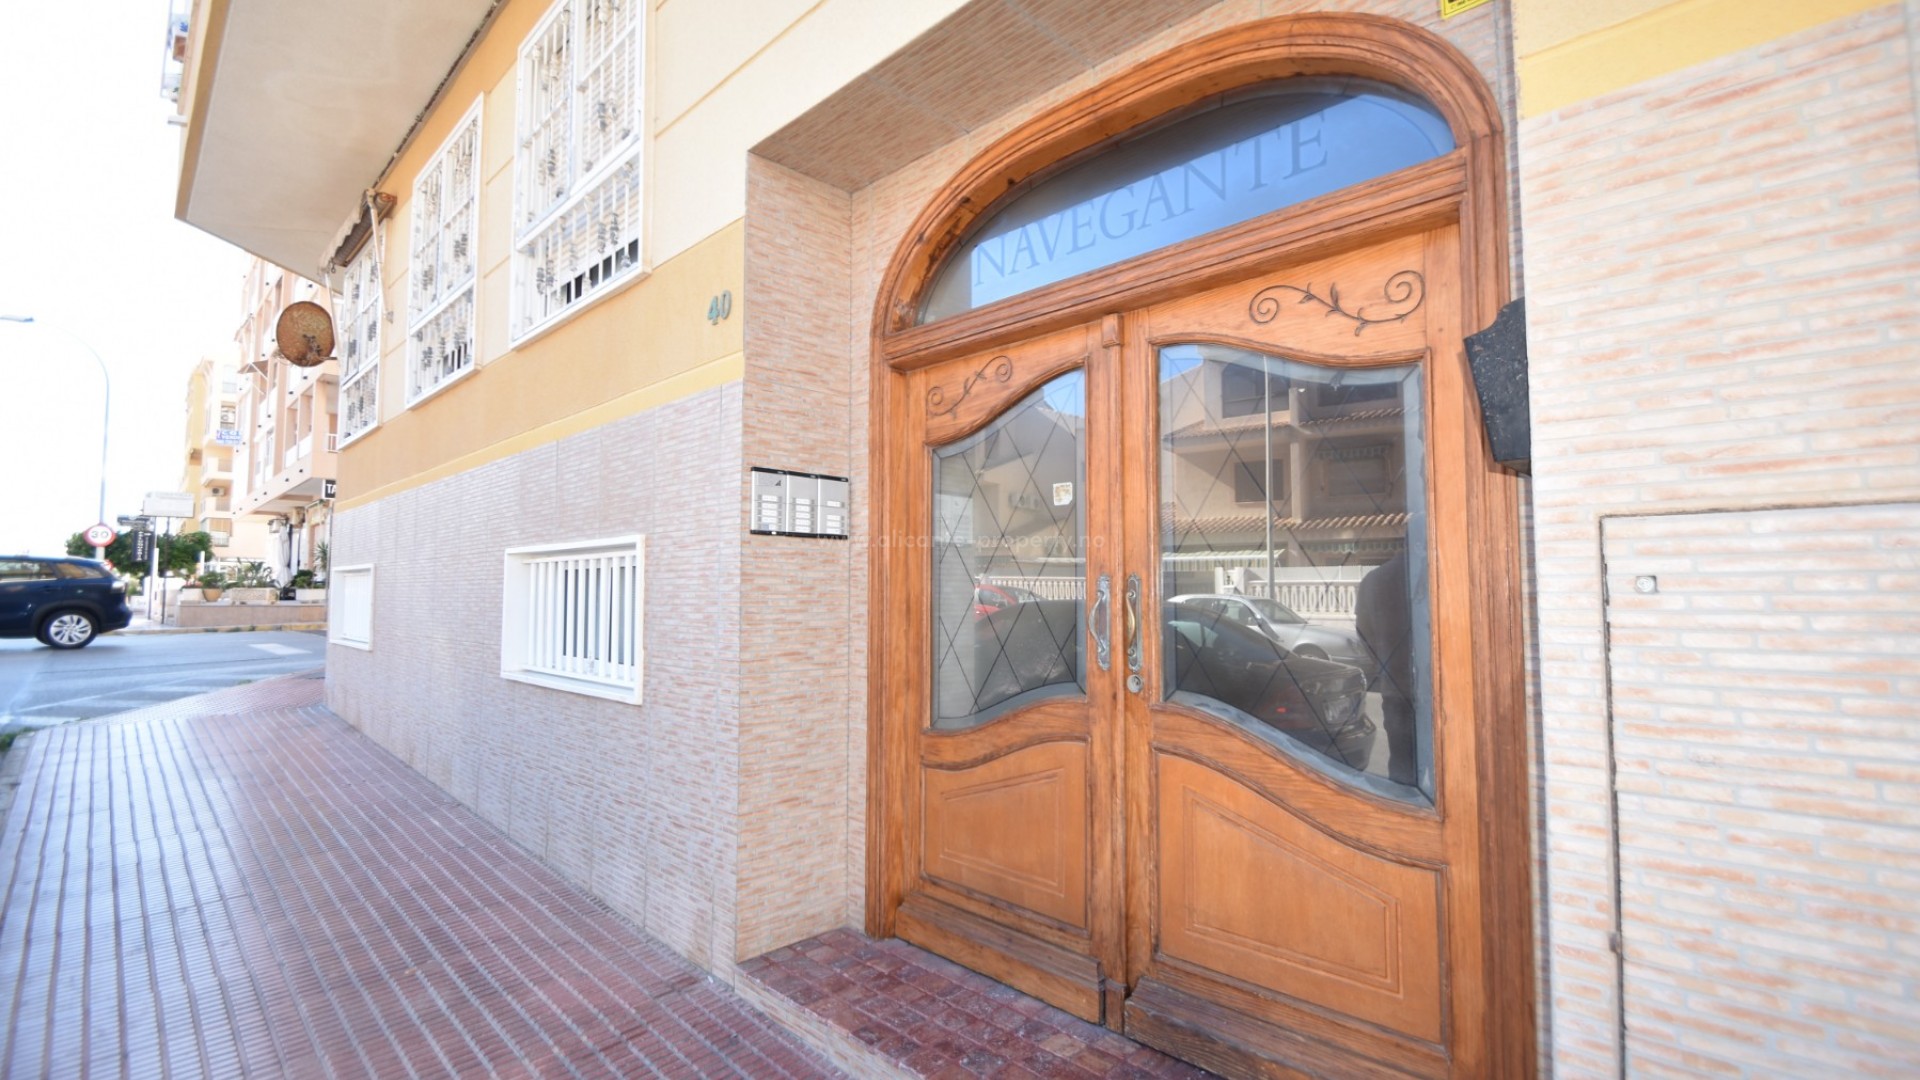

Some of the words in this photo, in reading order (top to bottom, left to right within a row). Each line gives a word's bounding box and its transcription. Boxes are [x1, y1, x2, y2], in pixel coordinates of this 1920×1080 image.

[974, 110, 1328, 286] NAVEGANTE
[707, 290, 732, 326] 40
[91, 530, 109, 539] 30
